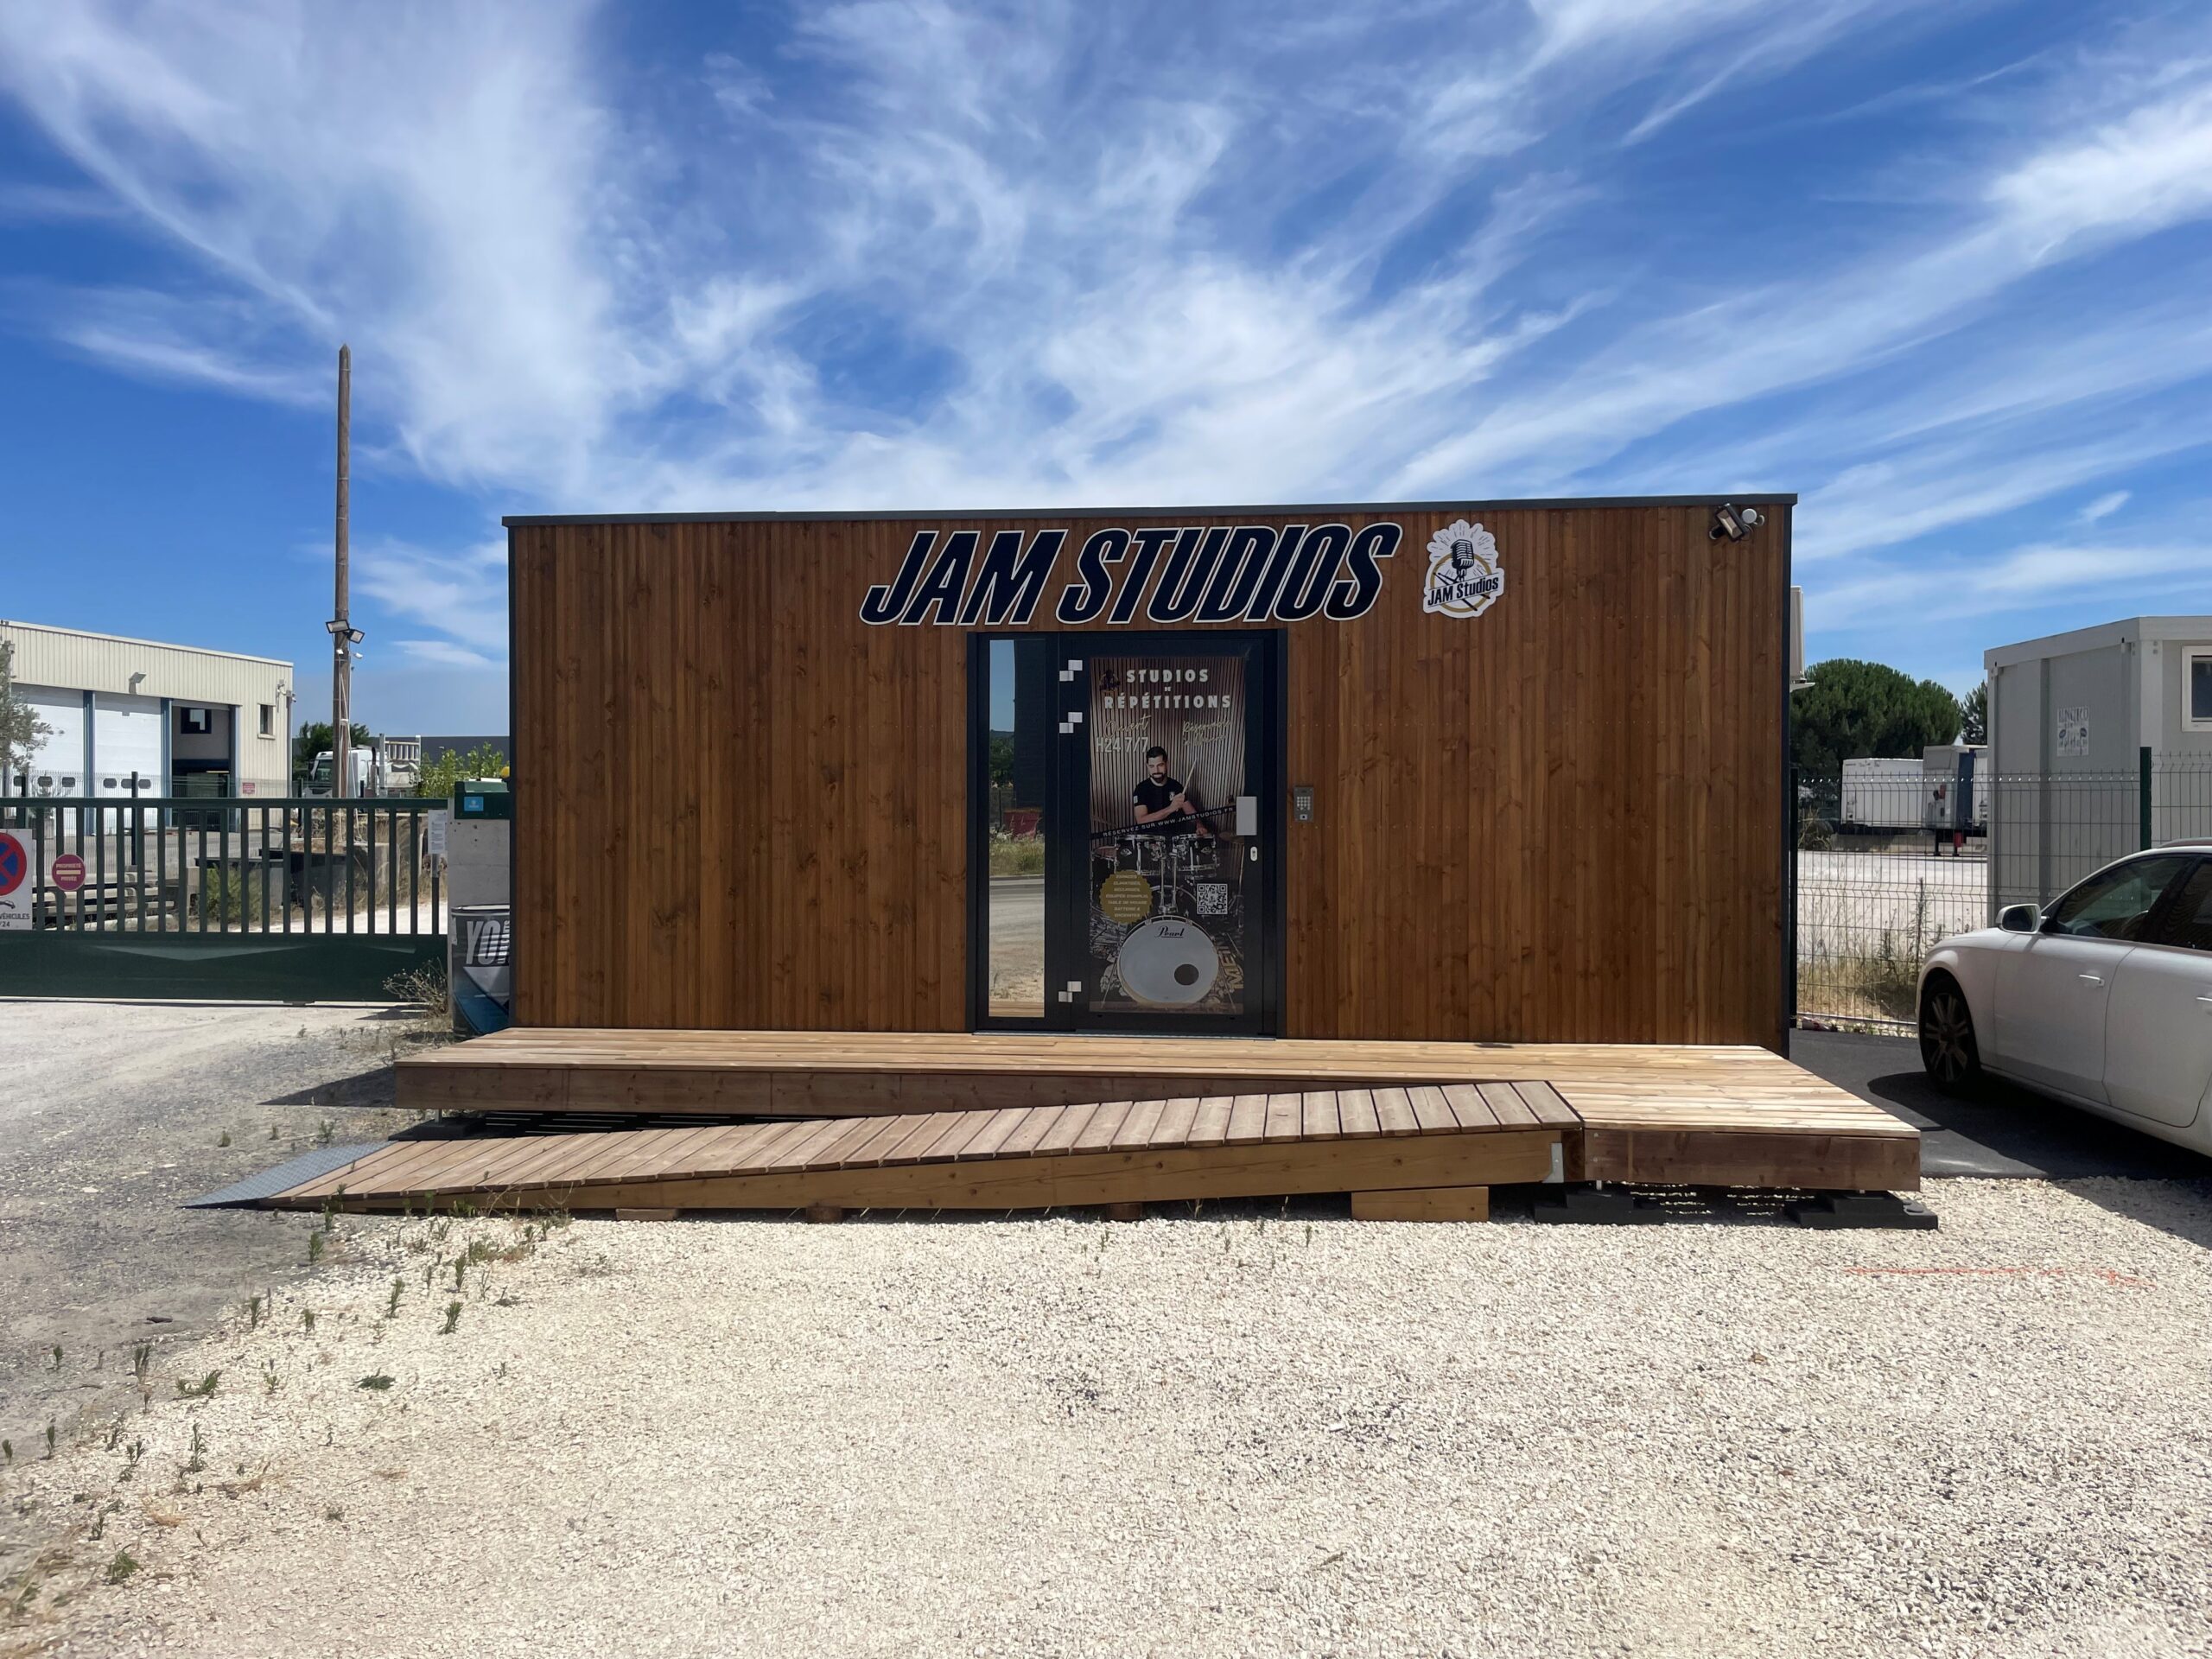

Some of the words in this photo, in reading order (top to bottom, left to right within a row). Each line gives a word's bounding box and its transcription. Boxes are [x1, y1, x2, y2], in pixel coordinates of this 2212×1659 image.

[859, 529, 1069, 626] JAM
[1055, 522, 1403, 625] STUDIOS
[1427, 585, 1453, 606] JAM
[1456, 576, 1499, 599] Studios
[1126, 669, 1209, 683] STUDIOS
[1104, 692, 1231, 709] RÉPÉTITIONS
[1103, 714, 1152, 738] Ouvert
[1096, 737, 1122, 753] H24
[1124, 737, 1149, 753] 7/7
[1154, 925, 1185, 938] Pearl
